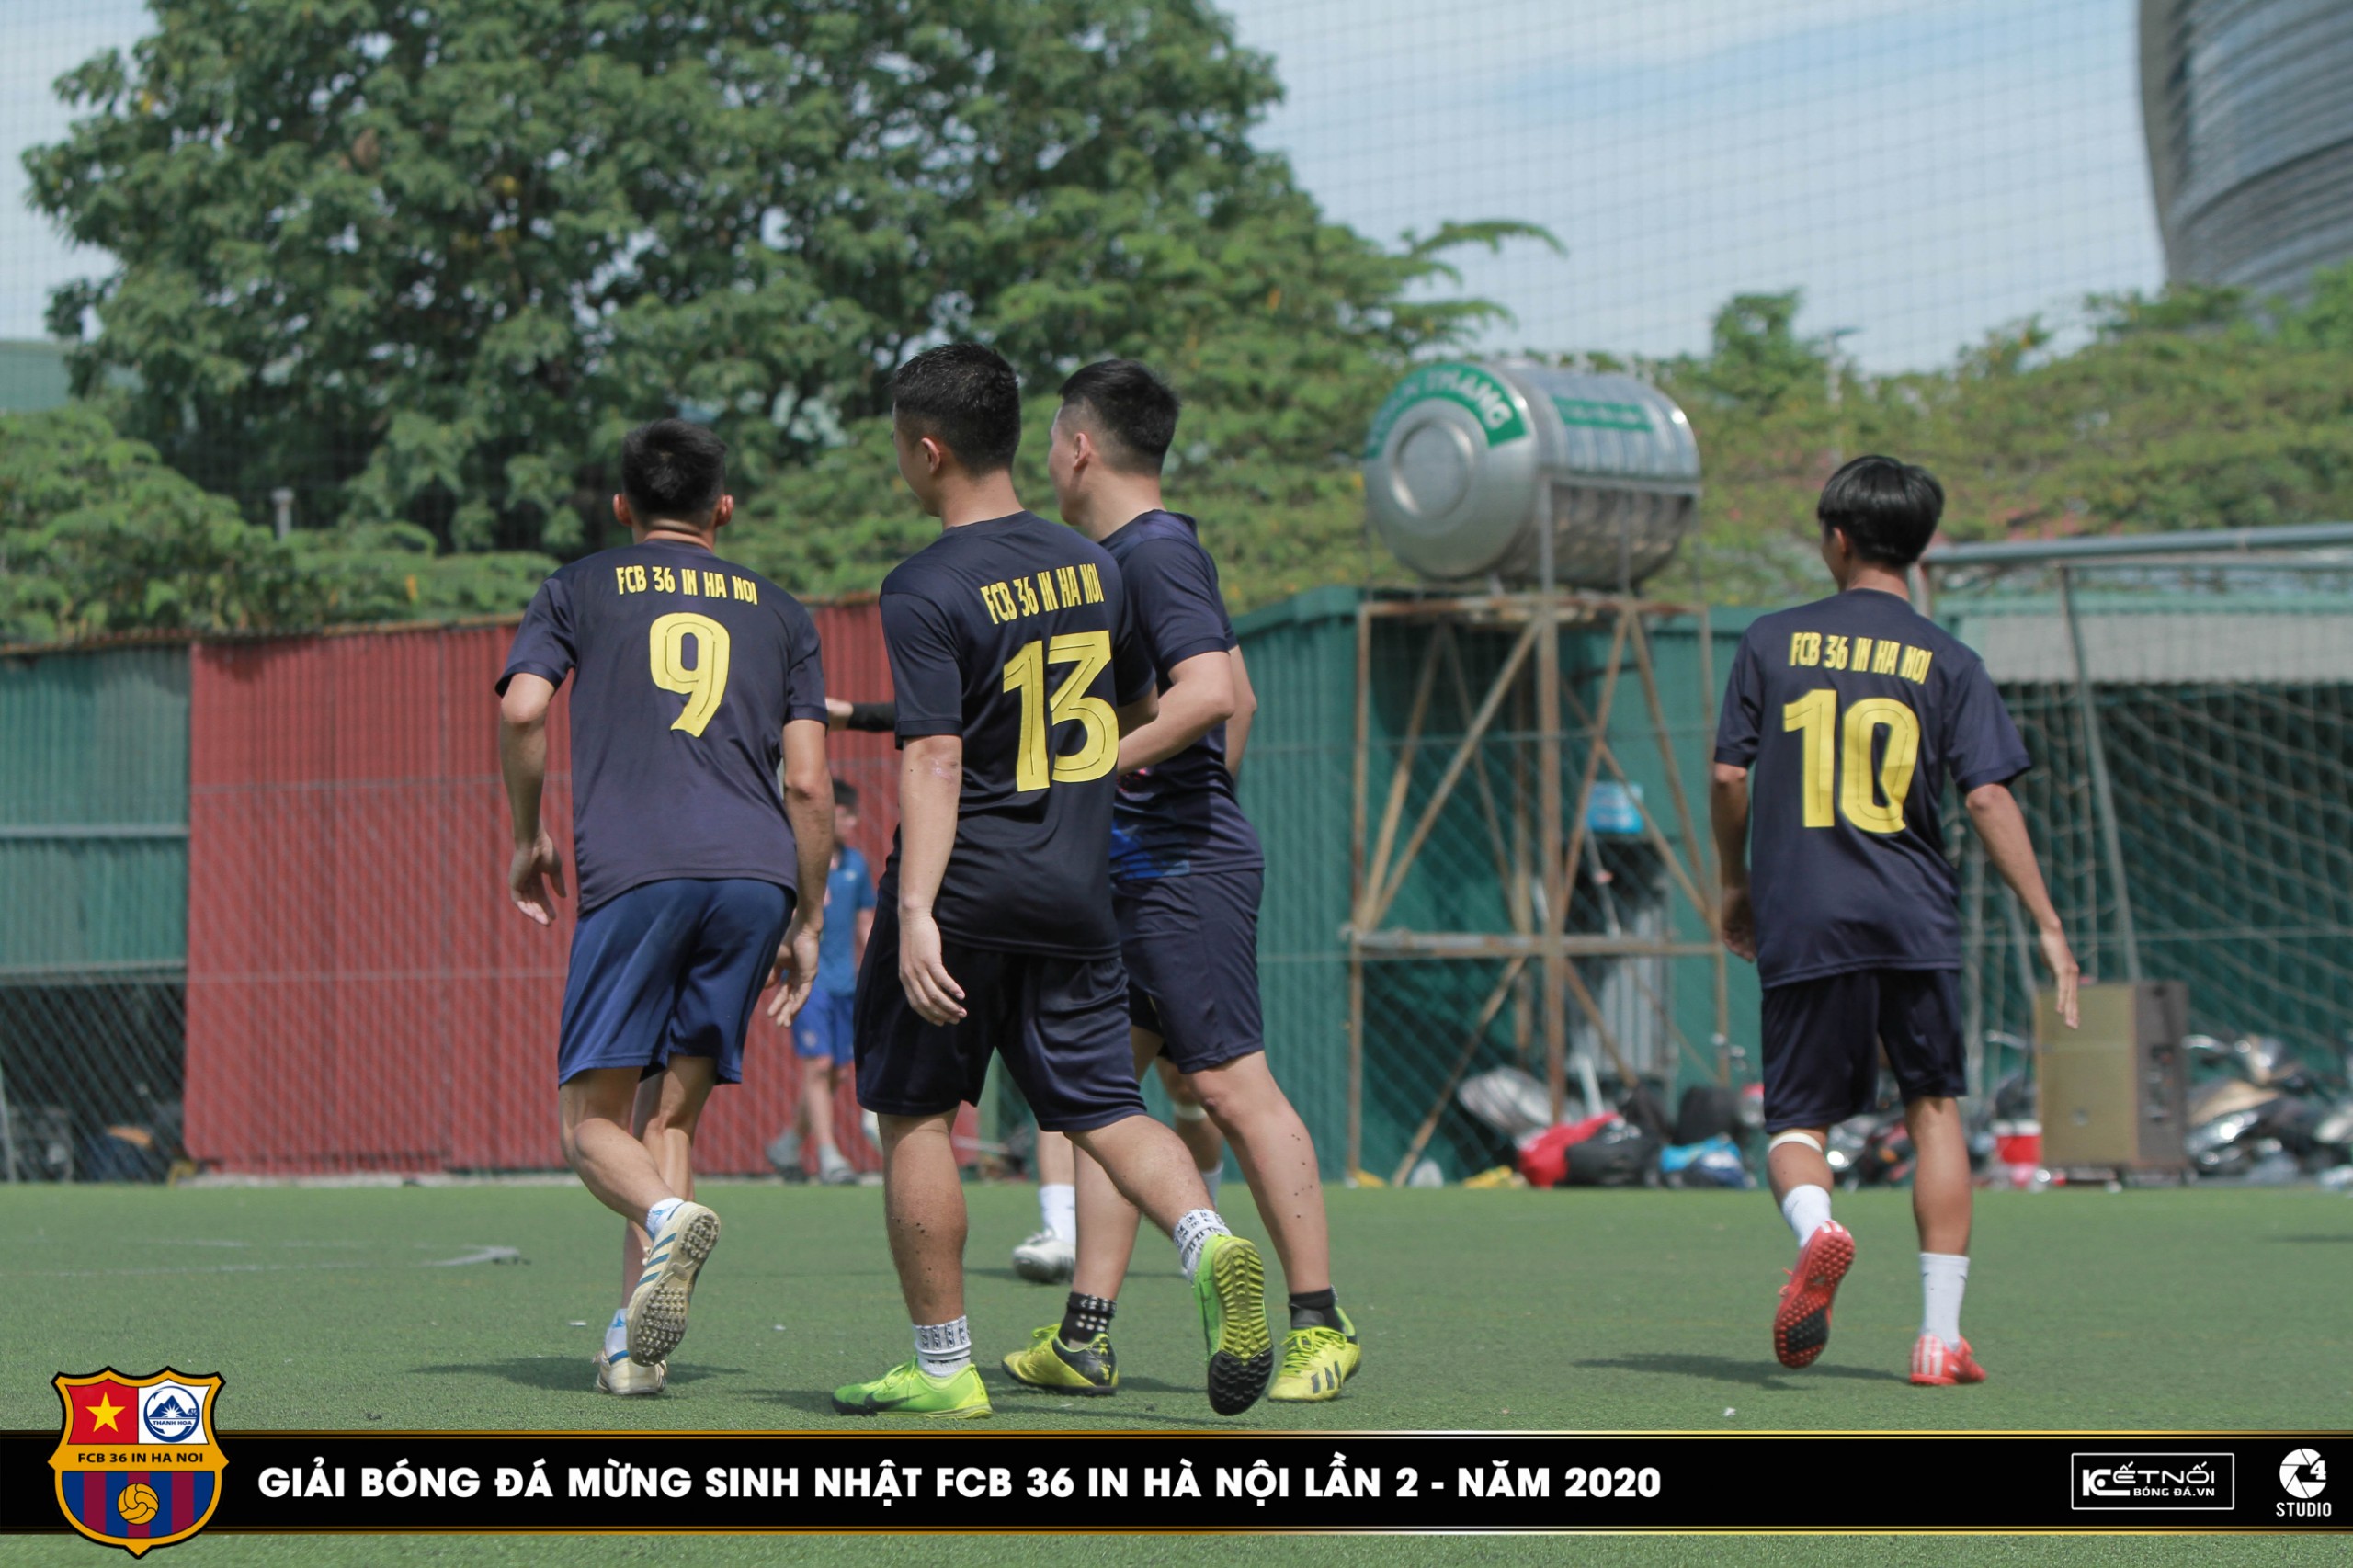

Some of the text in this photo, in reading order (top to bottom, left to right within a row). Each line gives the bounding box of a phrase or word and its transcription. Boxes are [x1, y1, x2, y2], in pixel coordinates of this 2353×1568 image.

[616, 565, 758, 605] FCB 36 IN HA NOI
[980, 563, 1104, 624] FCB 36 IN HA NOI
[650, 612, 730, 737] 9
[1789, 631, 1933, 685] FCB 36 IN HA NOI
[1003, 630, 1120, 791] 13
[1783, 689, 1920, 834] 10
